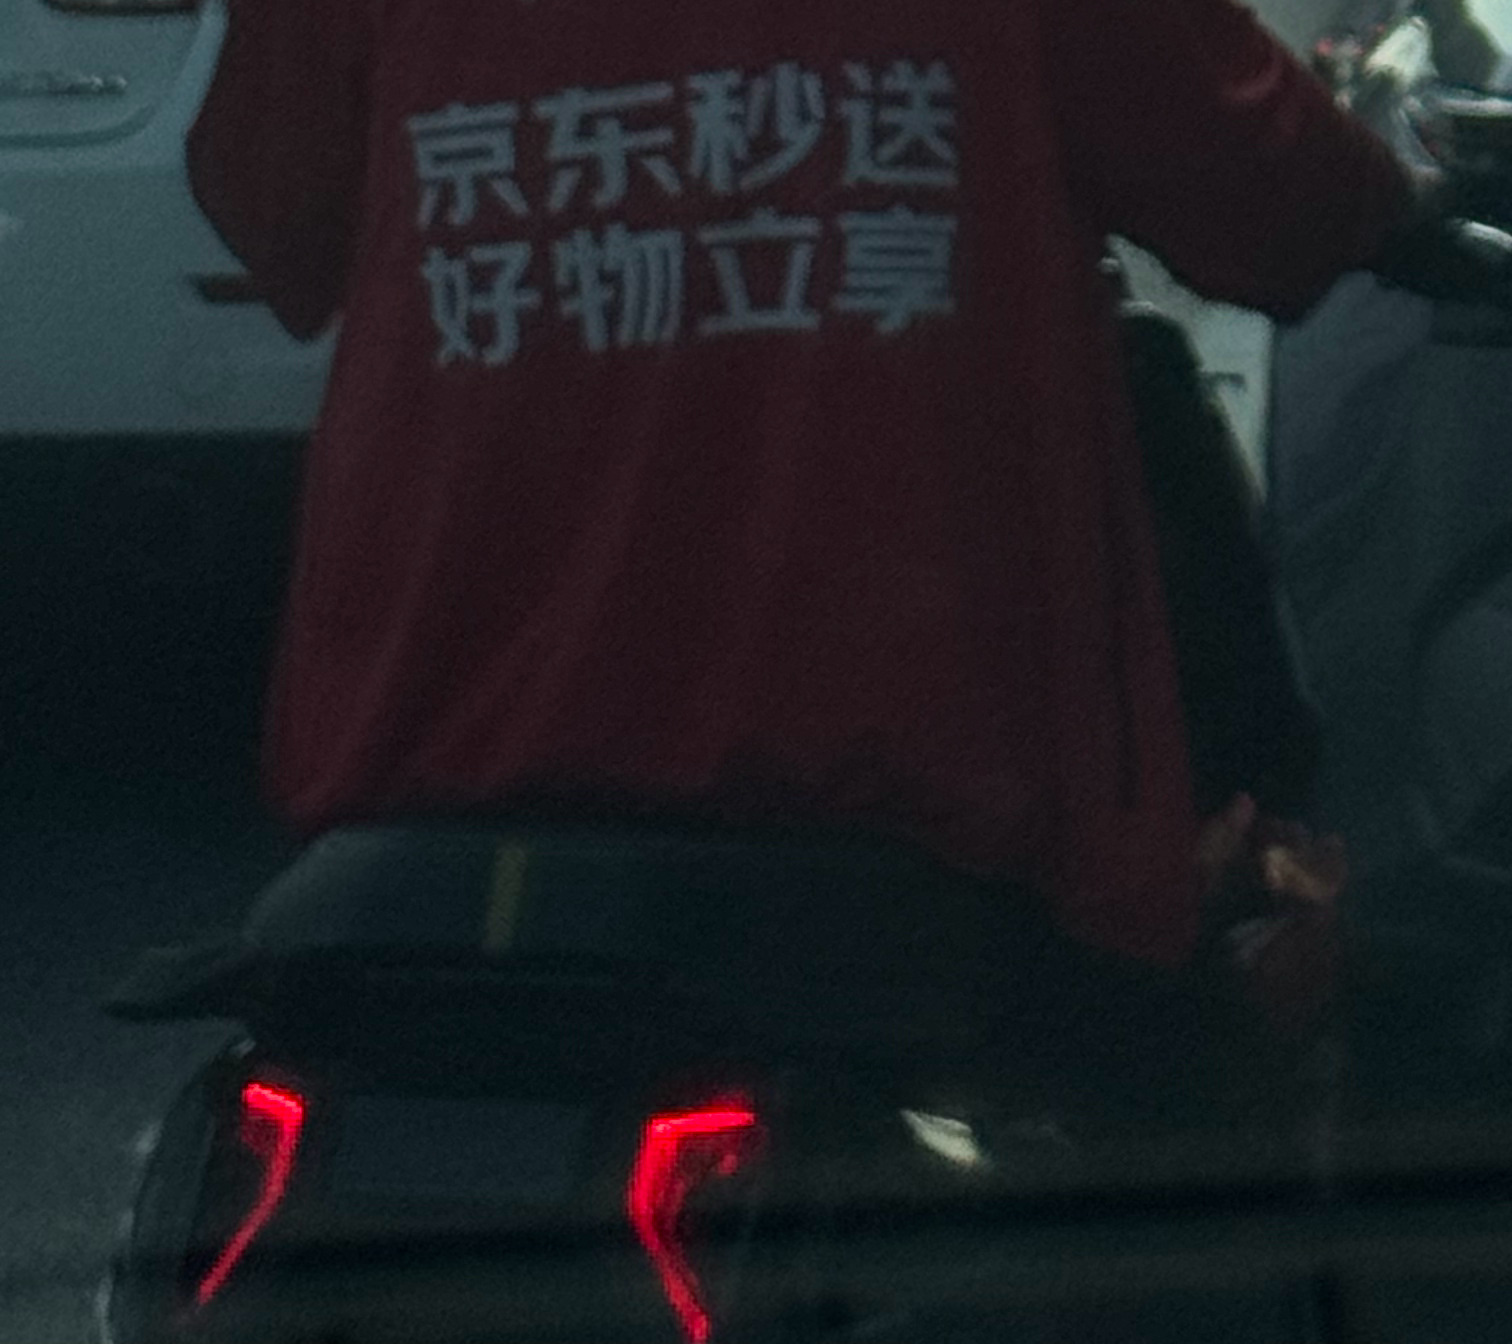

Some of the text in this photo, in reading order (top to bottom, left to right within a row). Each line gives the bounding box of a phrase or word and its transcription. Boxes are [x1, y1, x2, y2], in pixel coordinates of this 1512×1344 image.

[409, 60, 958, 228] 京东秒送
[420, 208, 958, 365] 好物立享
